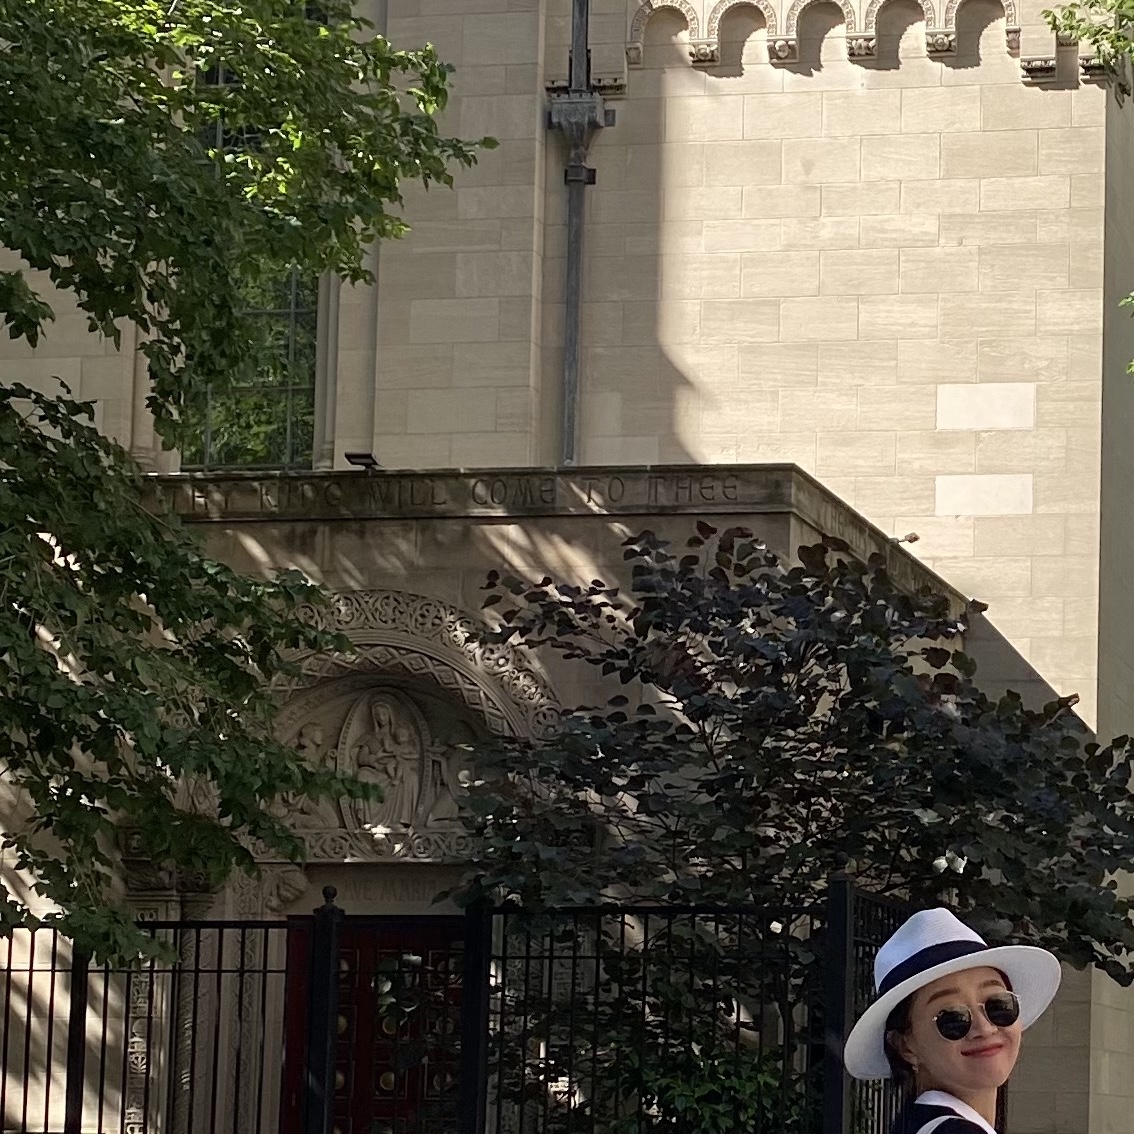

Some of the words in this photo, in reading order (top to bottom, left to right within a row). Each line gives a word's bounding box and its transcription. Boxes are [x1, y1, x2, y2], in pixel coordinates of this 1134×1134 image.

[365, 478, 447, 511] WILL
[472, 477, 557, 507] COME
[580, 475, 626, 504] TO
[647, 473, 739, 504] THEE
